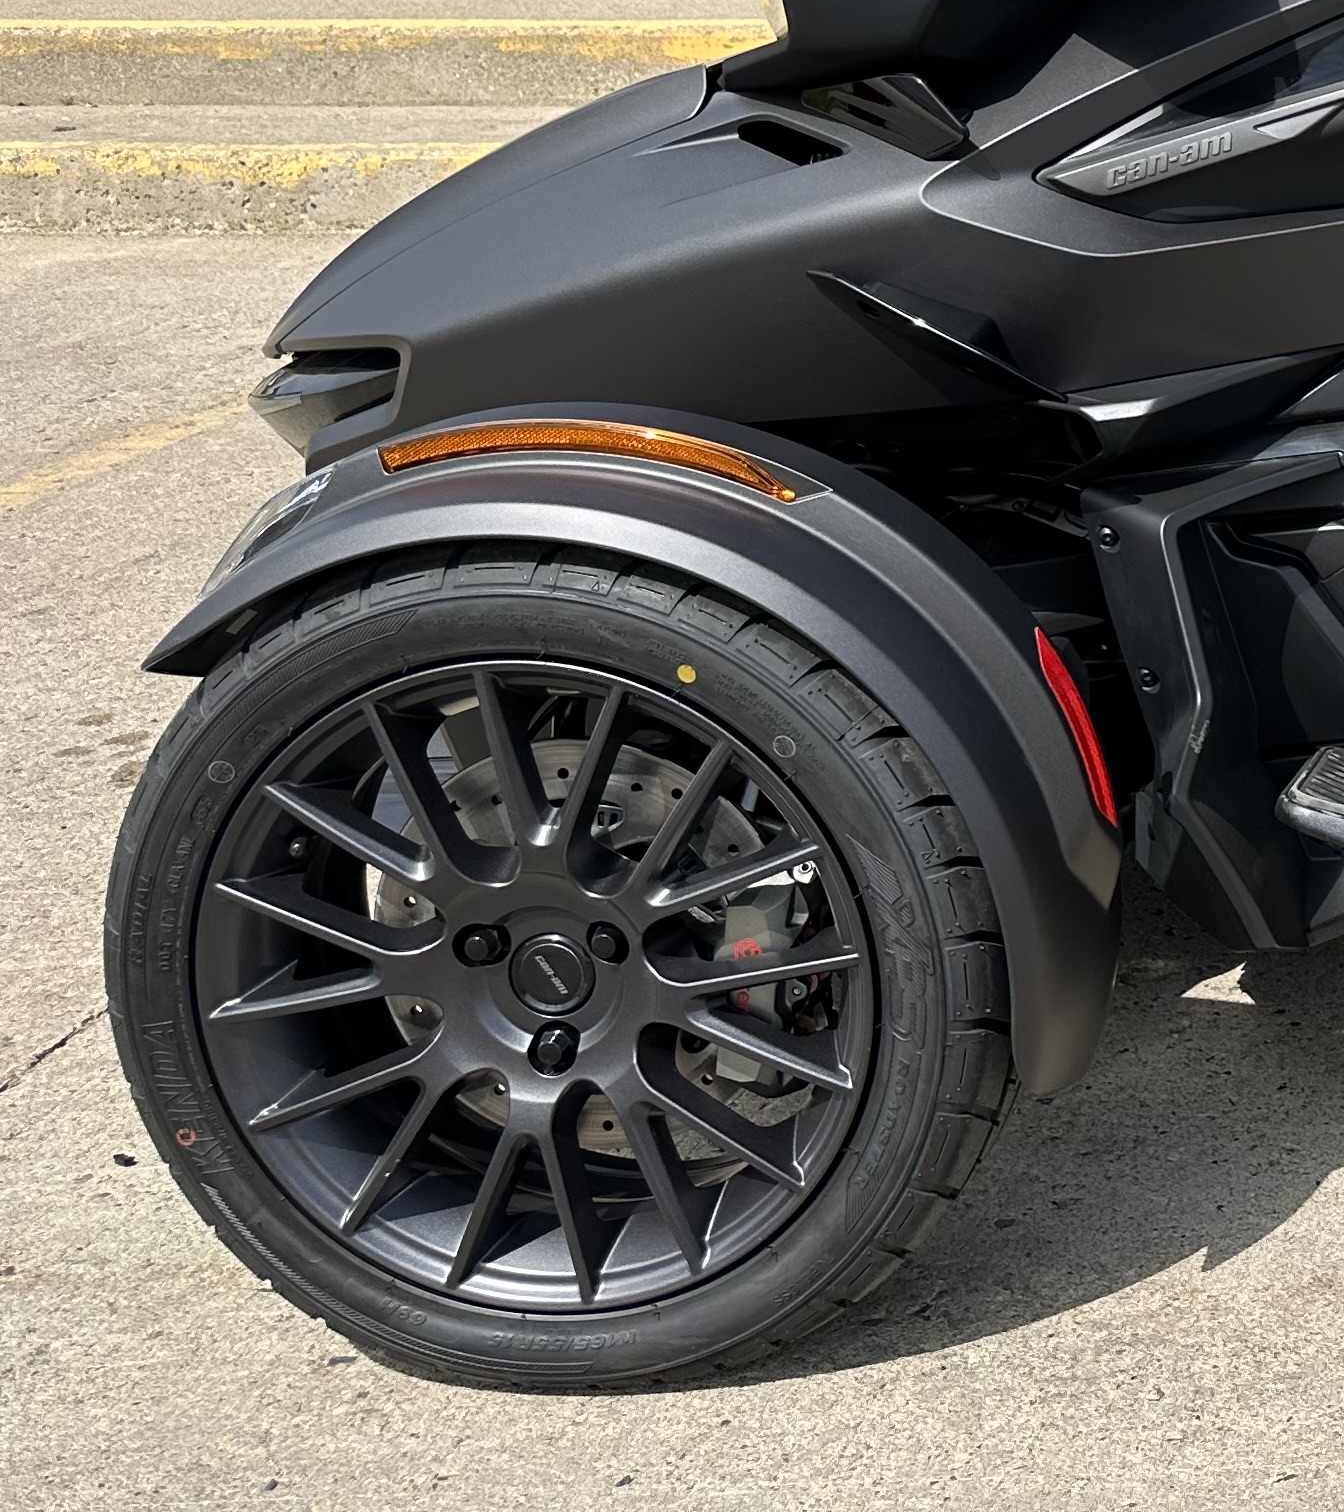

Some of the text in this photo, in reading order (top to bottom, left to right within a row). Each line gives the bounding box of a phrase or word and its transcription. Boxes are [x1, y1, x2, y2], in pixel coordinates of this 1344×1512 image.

[1105, 130, 1234, 190] can-am
[534, 955, 569, 995] can-am
[141, 1020, 235, 1175] KENDA
